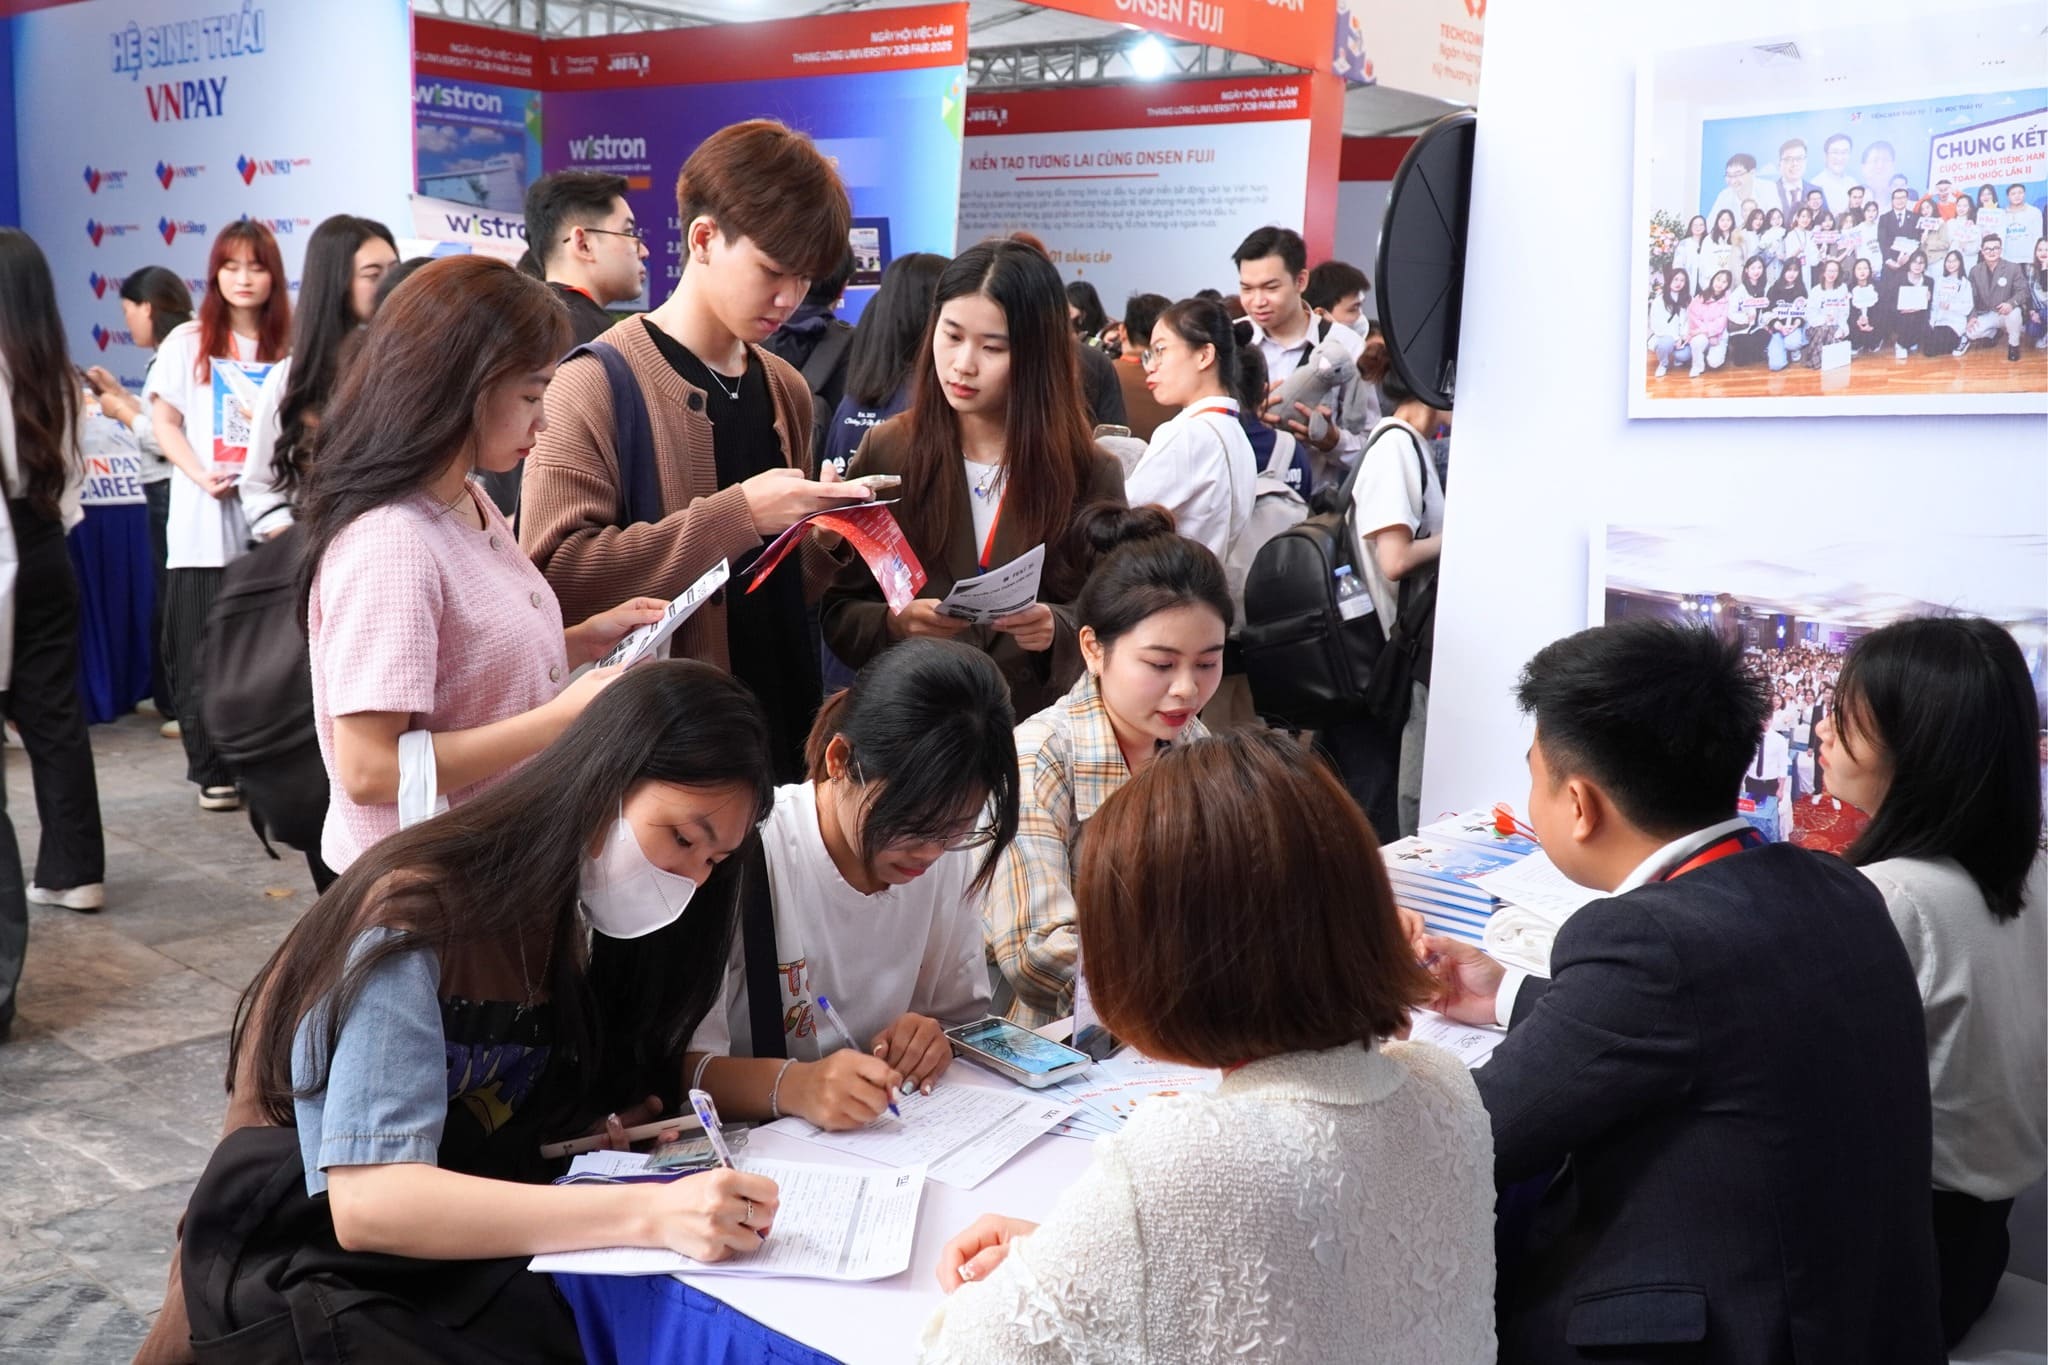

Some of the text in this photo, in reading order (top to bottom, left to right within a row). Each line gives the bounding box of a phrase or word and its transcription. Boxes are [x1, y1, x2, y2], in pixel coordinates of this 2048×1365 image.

[1188, 2, 1224, 34] FUJI
[146, 20, 199, 67] SINH
[146, 75, 227, 122] VNPAY
[415, 83, 502, 113] wistron
[568, 134, 646, 160] wistron
[1936, 124, 2047, 159] CHUNG KẾT
[1136, 149, 1183, 166] ONSEN
[1187, 149, 1215, 163] FUJI
[445, 212, 528, 241] wistro
